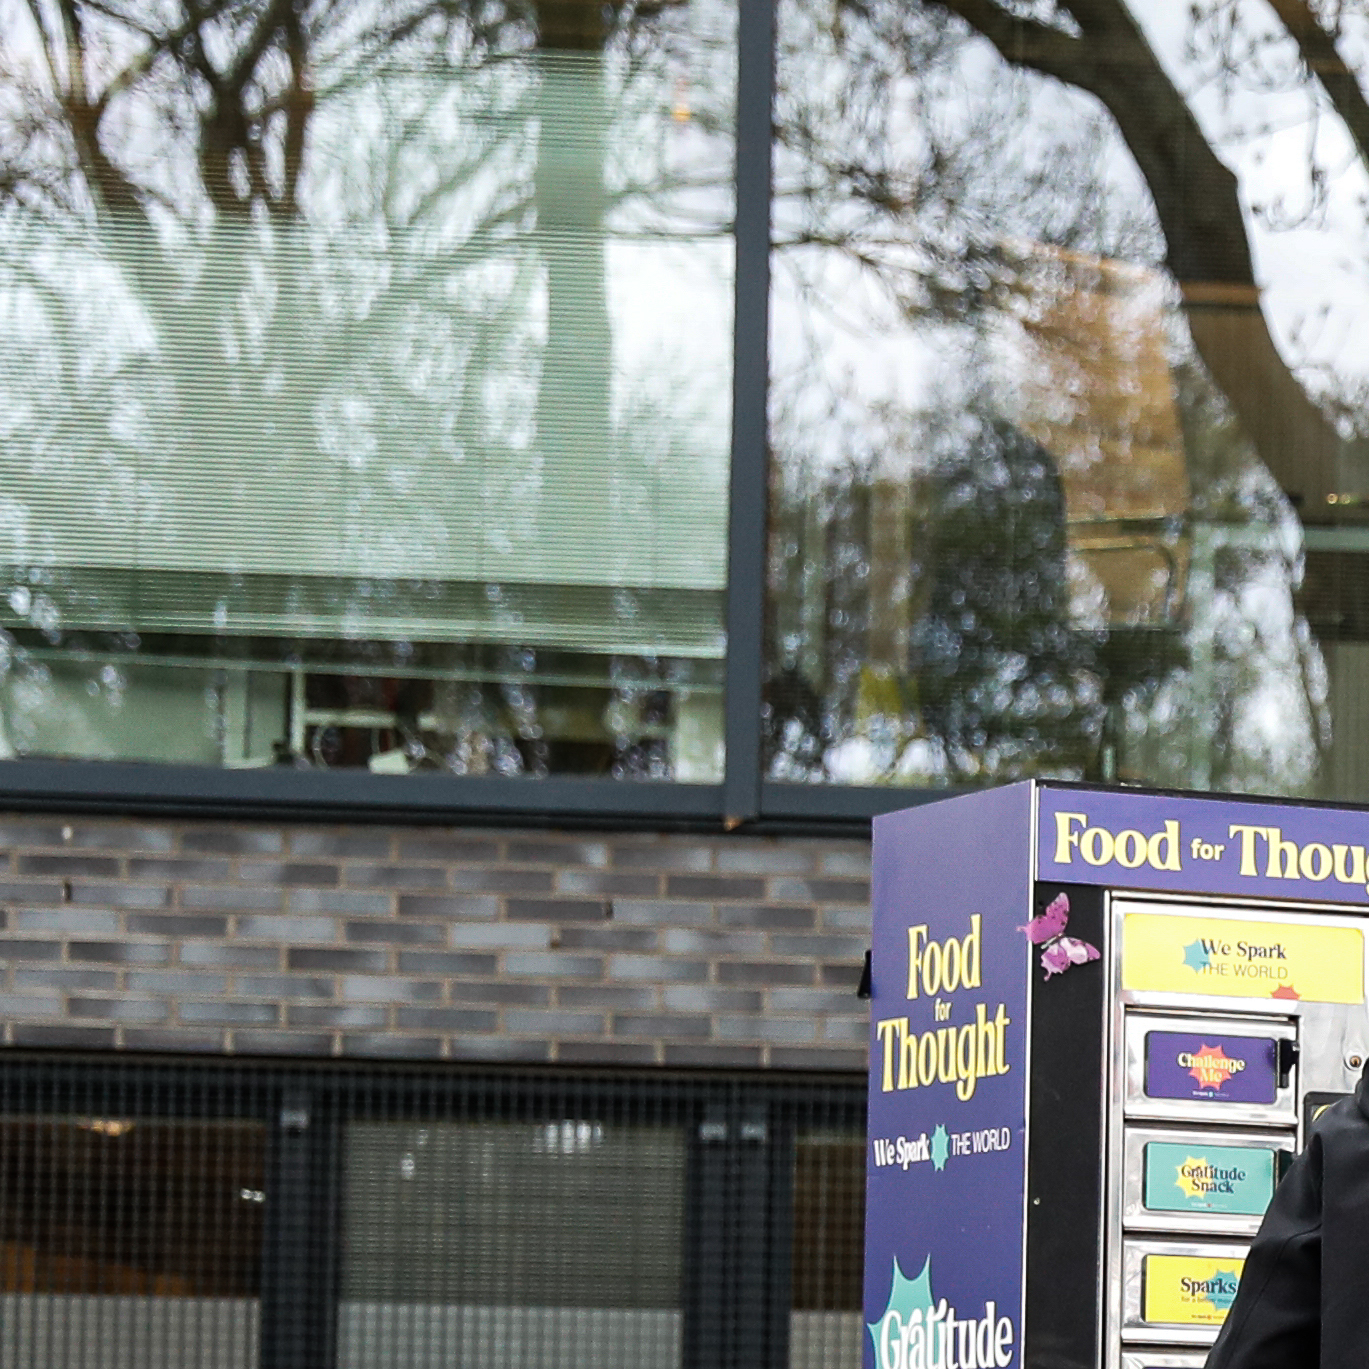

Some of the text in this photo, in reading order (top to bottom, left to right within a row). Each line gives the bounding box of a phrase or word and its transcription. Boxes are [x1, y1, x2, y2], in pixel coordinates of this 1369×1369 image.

[1053, 811, 1183, 873] Food
[1190, 837, 1225, 862] for
[906, 913, 981, 1000] Food
[1201, 938, 1287, 961] We Spark
[1200, 961, 1288, 980] THE WORLD
[934, 998, 951, 1022] for
[877, 1003, 1011, 1101] Thought
[1177, 1052, 1246, 1074] Challenge
[1201, 1069, 1222, 1082] Me
[873, 1127, 1011, 1171] We Spark THE WORLD
[1181, 1164, 1246, 1181] Gratitude
[1191, 1179, 1234, 1194] Snack
[1180, 1276, 1237, 1297] Sparks
